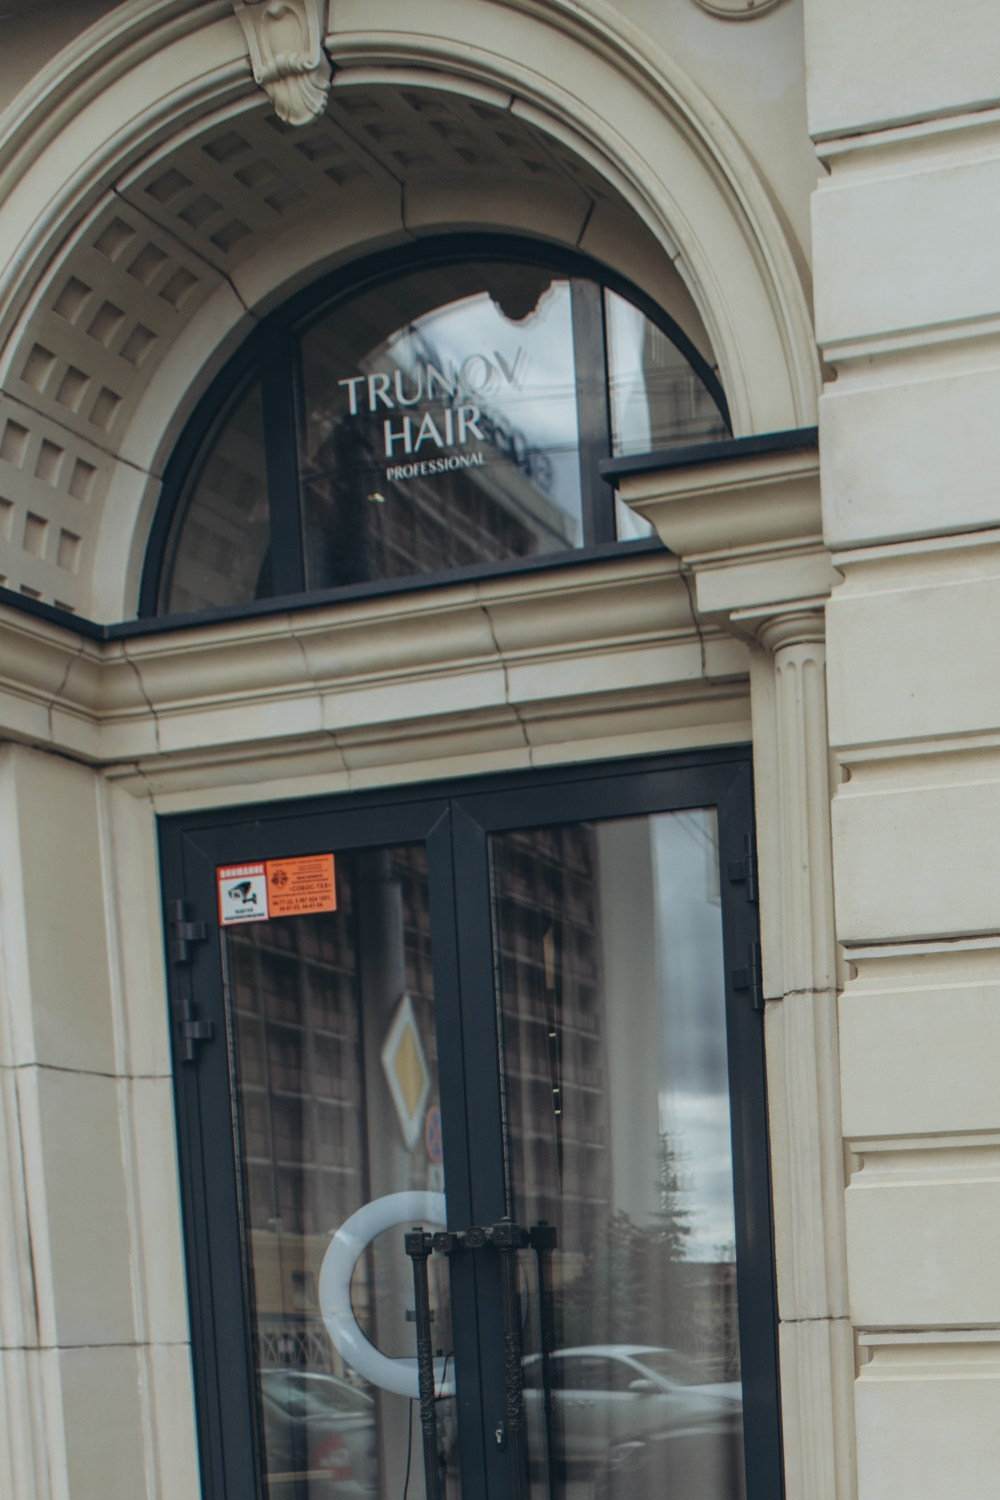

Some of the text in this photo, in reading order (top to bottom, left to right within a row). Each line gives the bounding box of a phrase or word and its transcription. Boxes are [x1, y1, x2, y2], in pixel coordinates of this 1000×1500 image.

[338, 347, 523, 415] TRUNOV
[384, 404, 485, 458] HAIR
[386, 451, 487, 482] PROFESSIONAL
